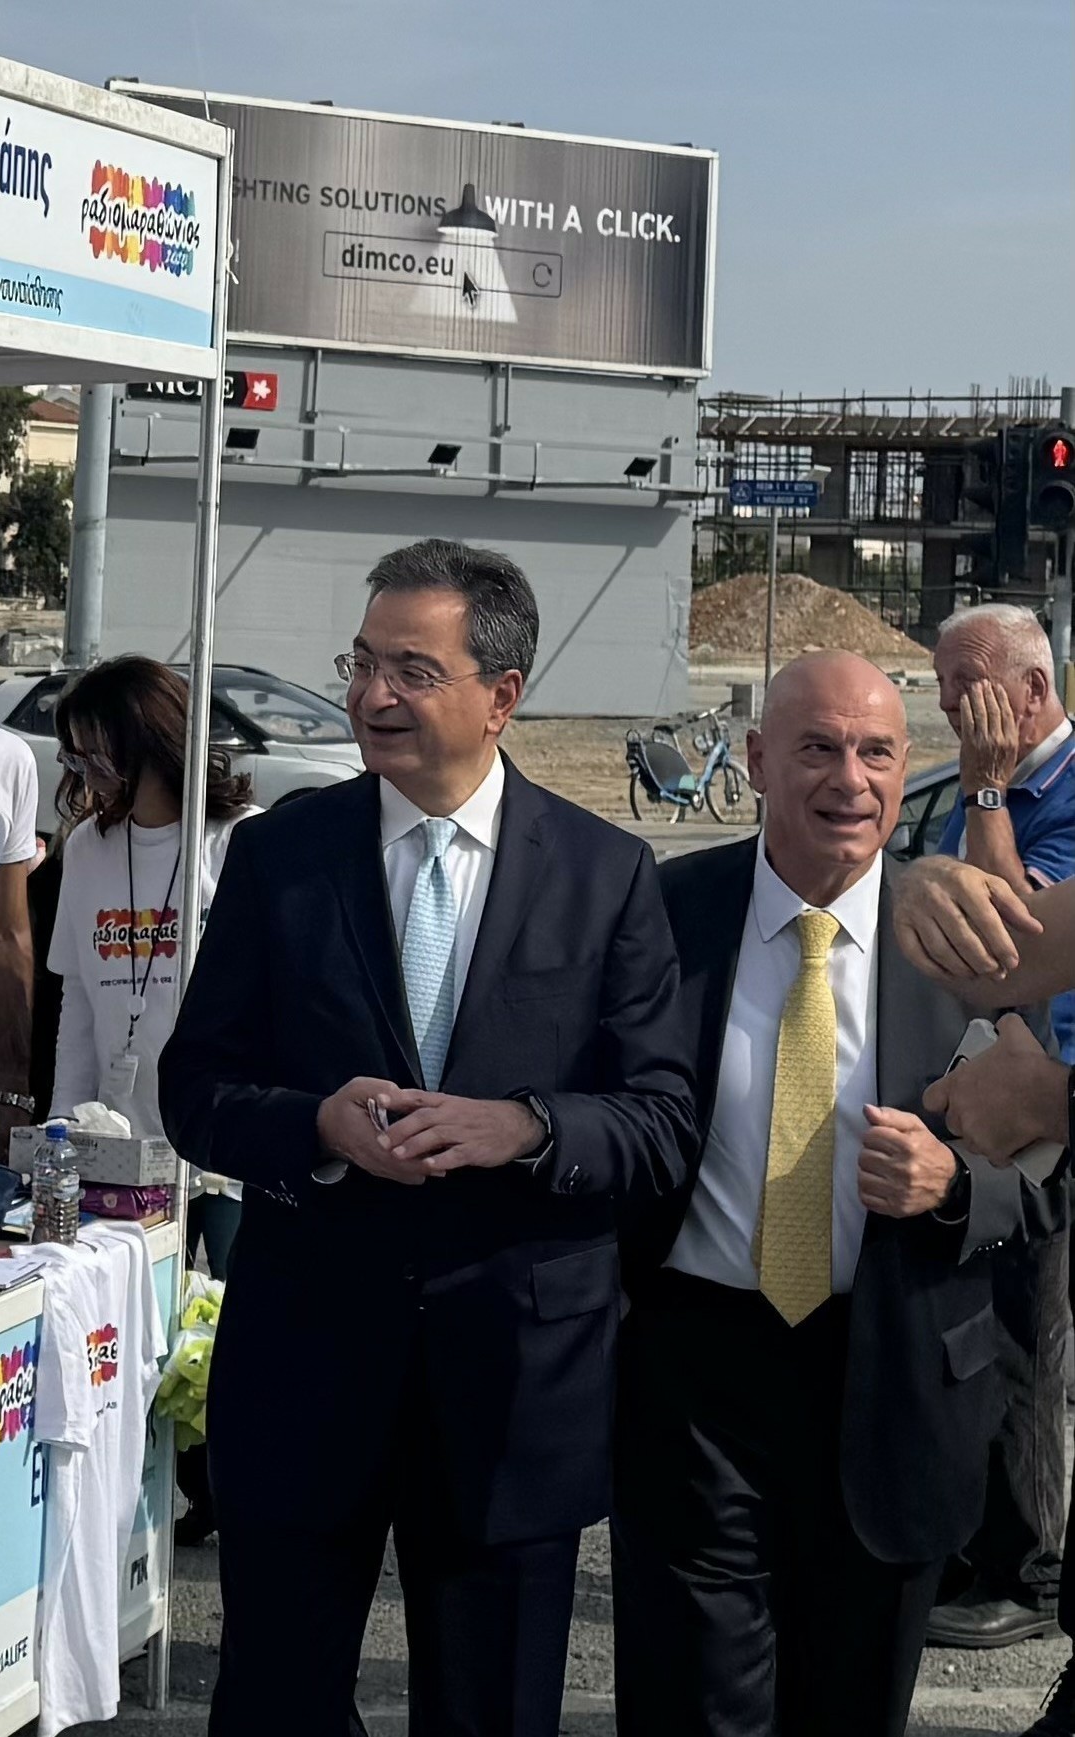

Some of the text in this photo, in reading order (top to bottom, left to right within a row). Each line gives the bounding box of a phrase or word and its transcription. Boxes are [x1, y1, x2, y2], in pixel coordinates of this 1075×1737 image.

[81, 187, 200, 249] ραδιομαραθώνιος
[232, 176, 681, 243] GHTING SOLUTIONS WITH A CLICK.
[341, 243, 454, 277] dimco.eu
